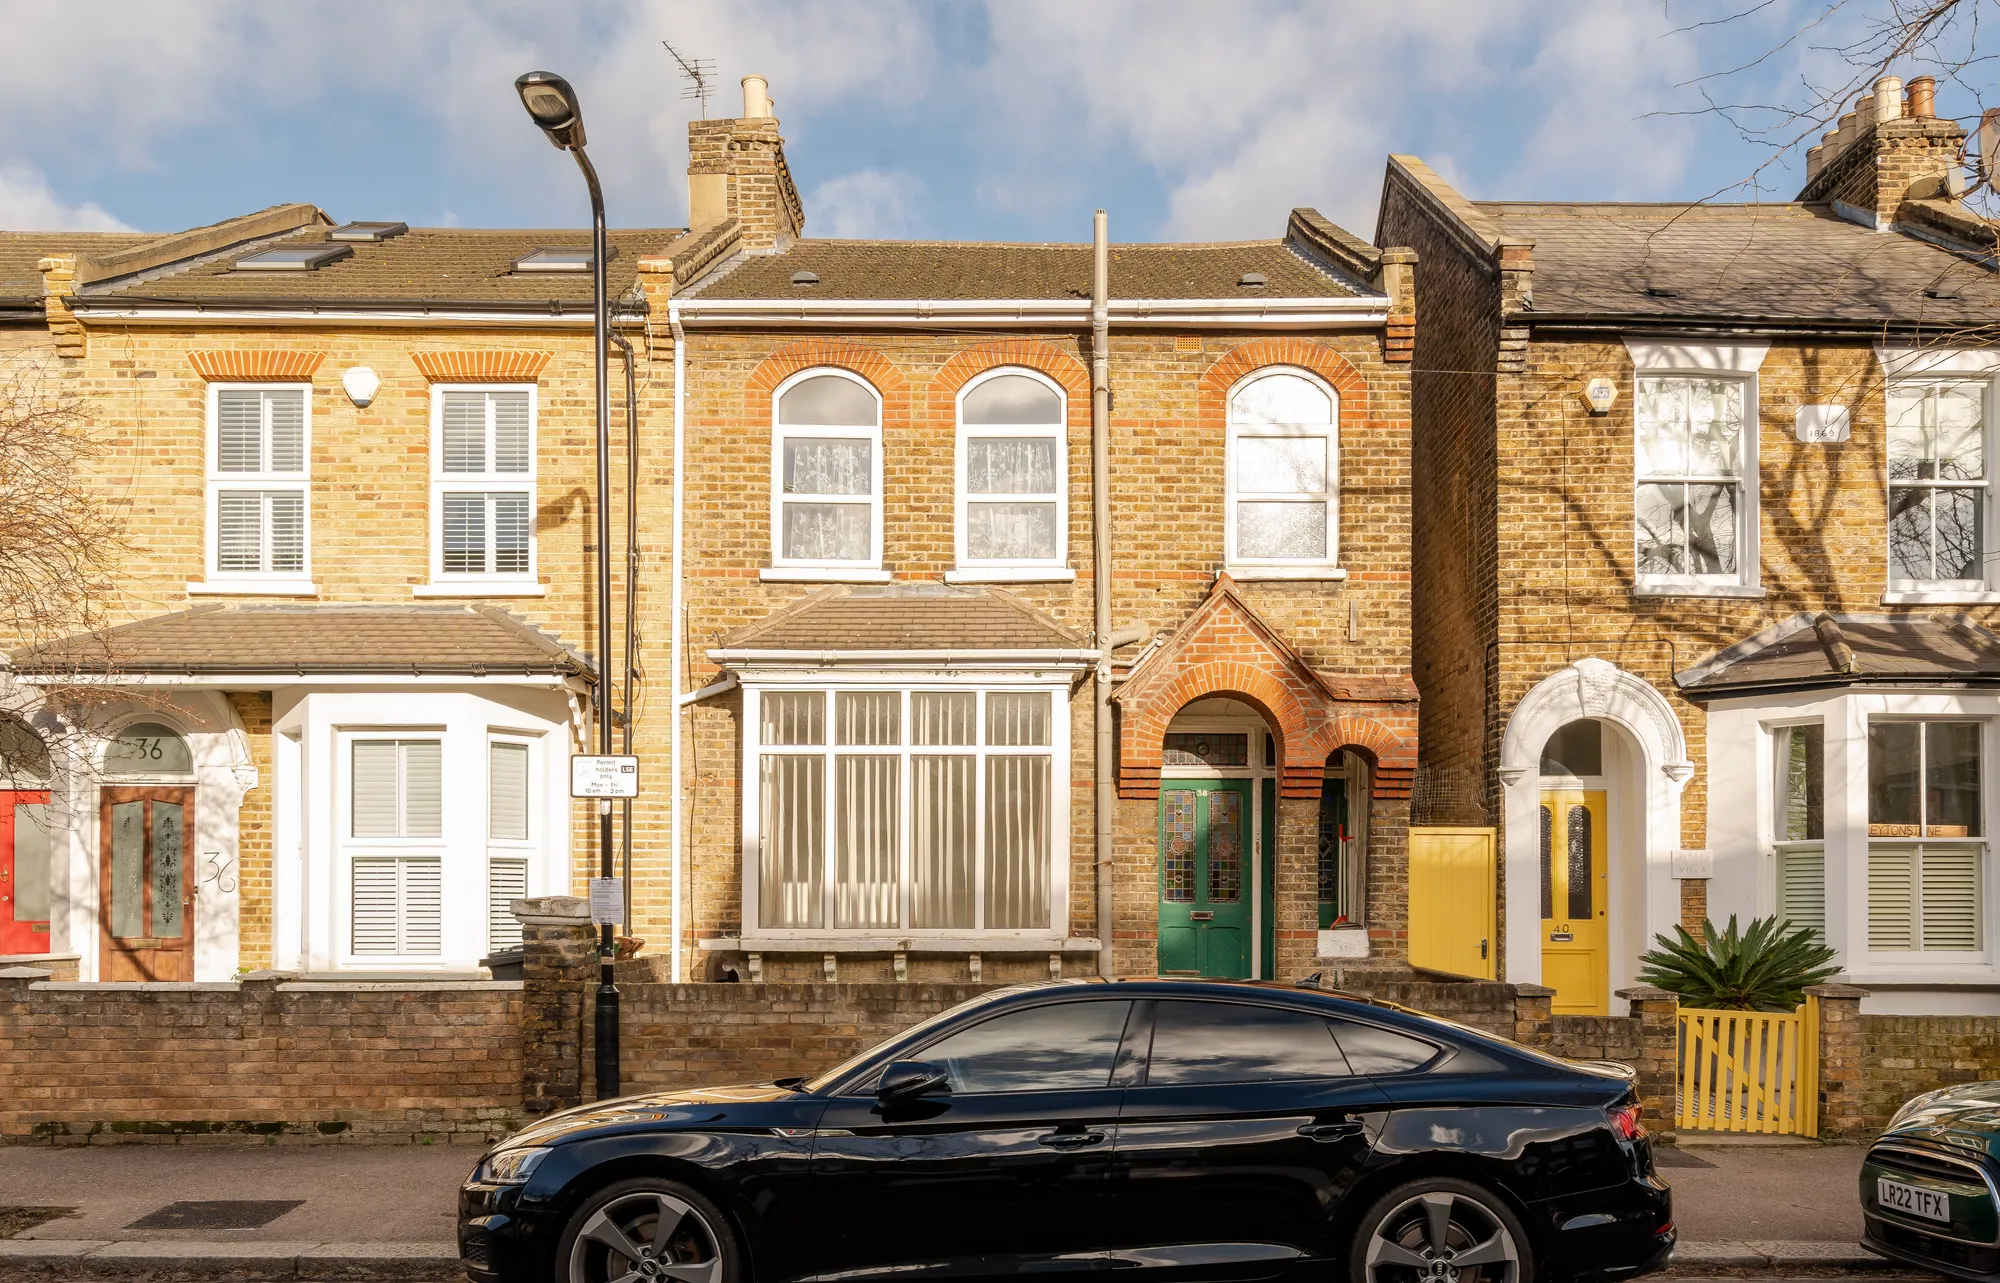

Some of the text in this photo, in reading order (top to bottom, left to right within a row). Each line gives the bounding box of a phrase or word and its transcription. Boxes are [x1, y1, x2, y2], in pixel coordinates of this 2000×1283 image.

[1593, 389, 1610, 397] ADT
[135, 738, 163, 760] 36
[1868, 825, 1942, 836] EYTONSTNE
[202, 852, 236, 893] 36
[1553, 923, 1570, 933] 40
[1882, 1182, 1943, 1217] LR22 TFX
